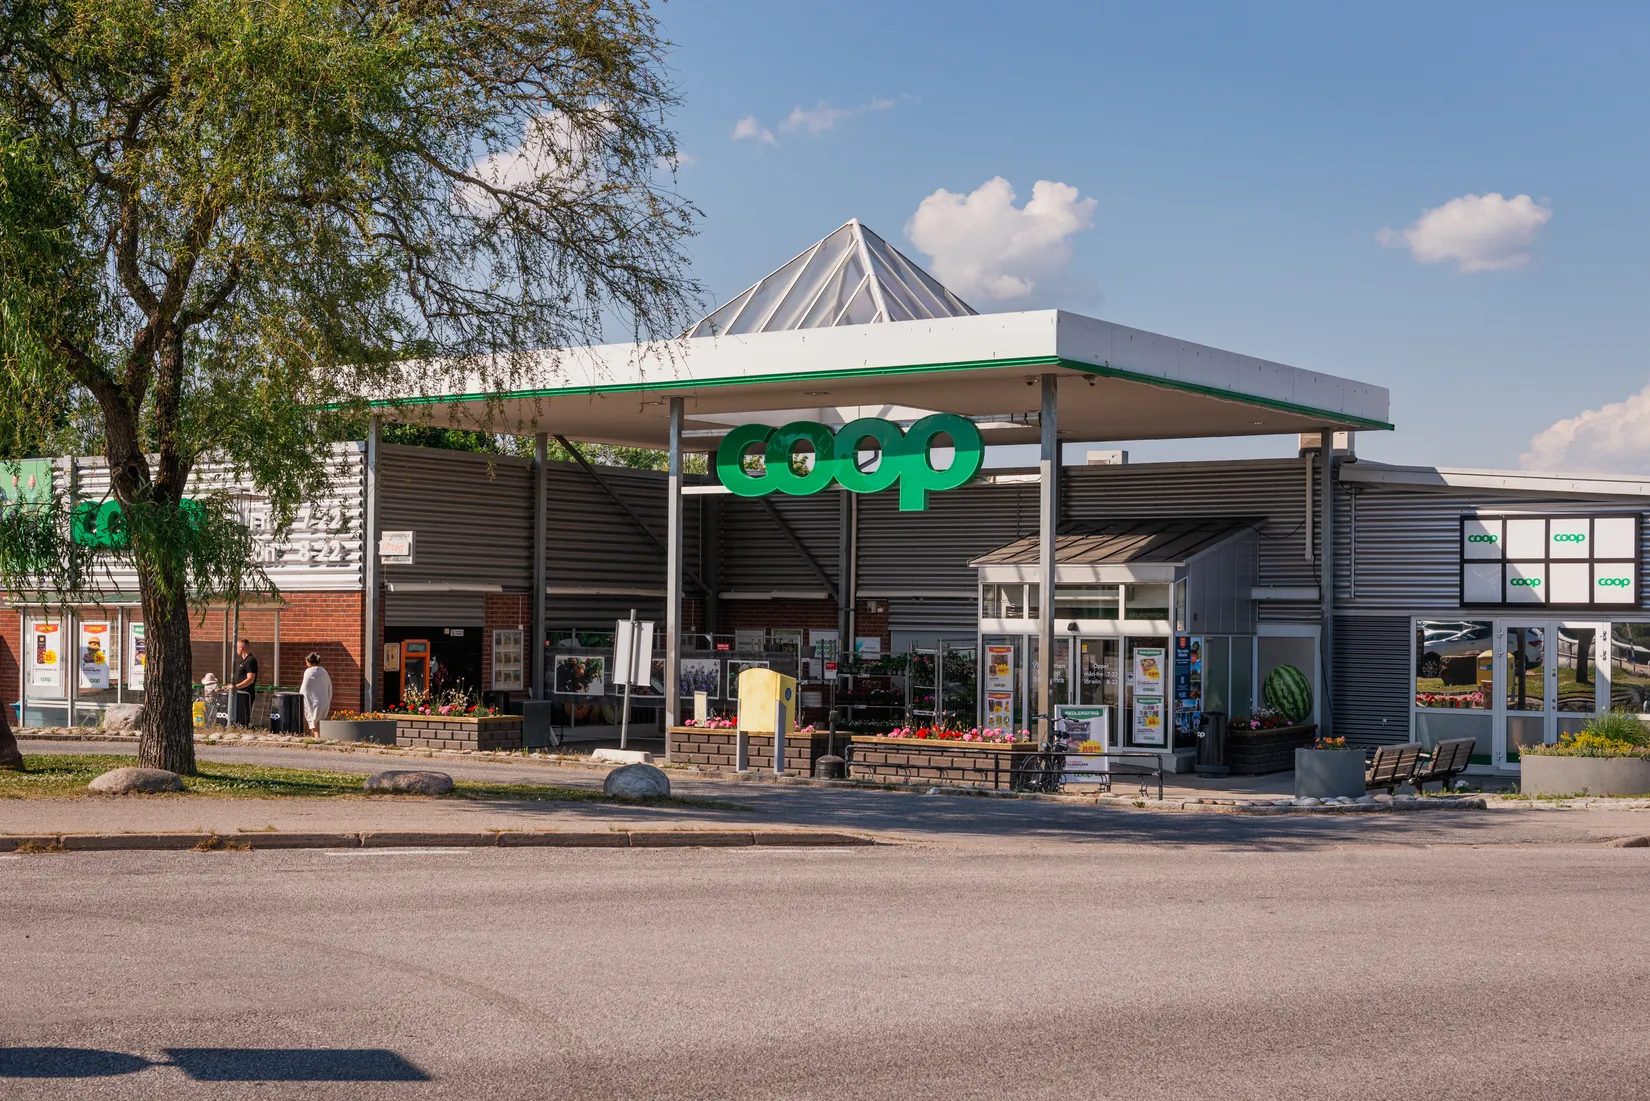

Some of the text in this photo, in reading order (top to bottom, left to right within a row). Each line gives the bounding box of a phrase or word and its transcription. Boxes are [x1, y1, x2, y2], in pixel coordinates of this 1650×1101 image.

[717, 413, 985, 511] coop
[1468, 534, 1498, 544] coop
[1553, 533, 1586, 543] coop
[1510, 577, 1541, 588] coop
[1598, 577, 1631, 588] coop
